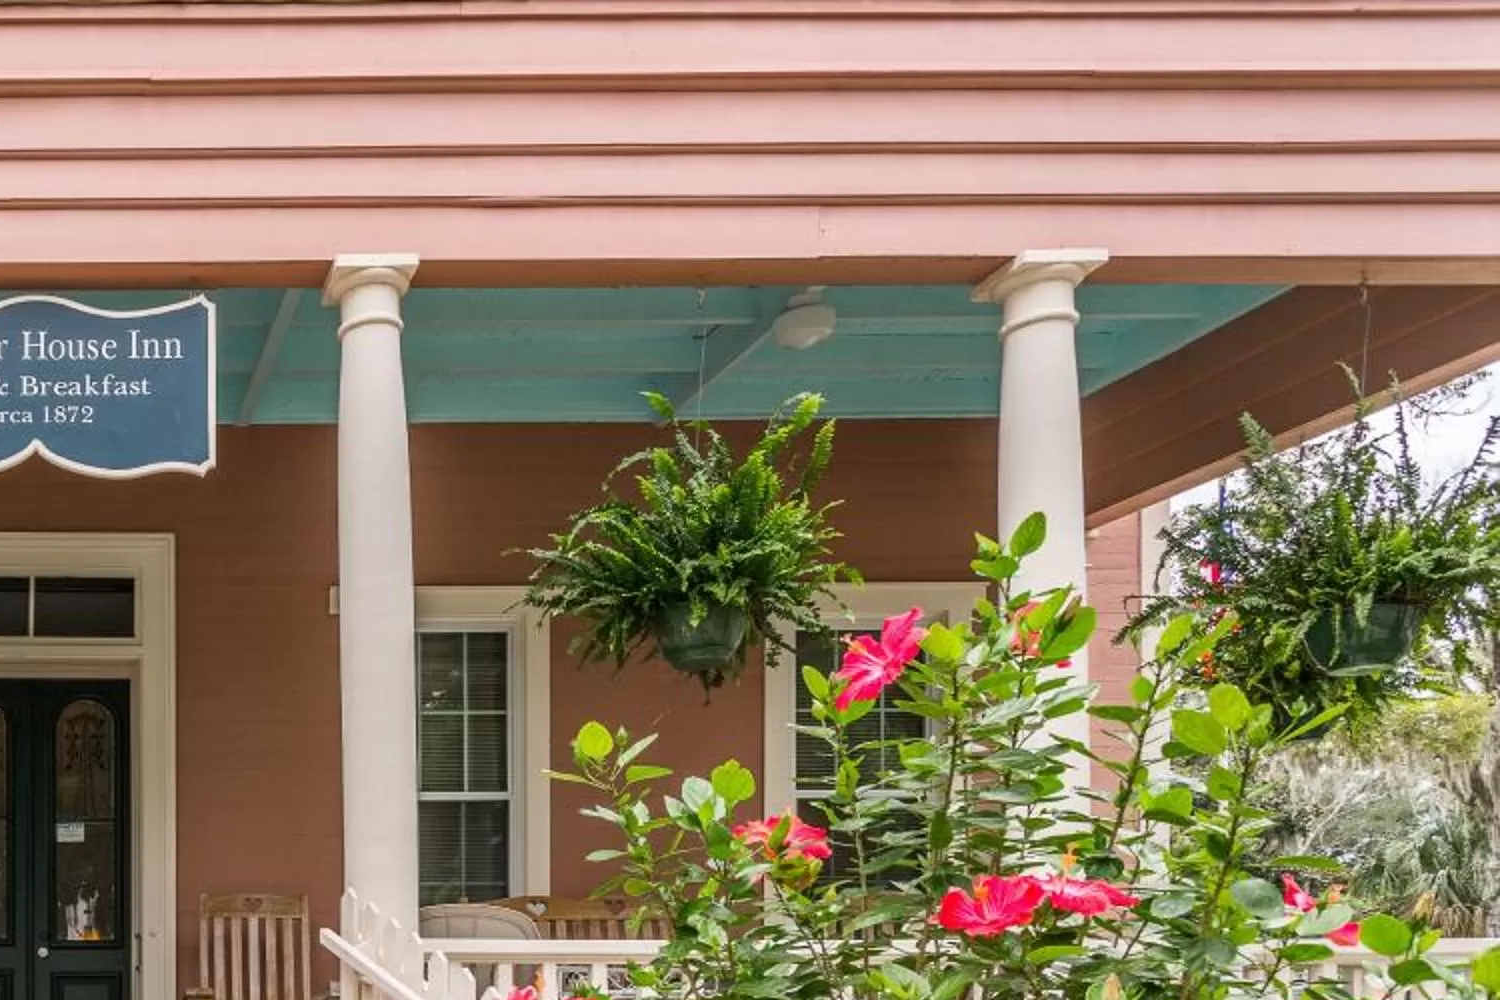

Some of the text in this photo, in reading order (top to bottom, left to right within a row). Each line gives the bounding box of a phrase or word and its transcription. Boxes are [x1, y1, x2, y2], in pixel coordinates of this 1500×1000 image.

[22, 331, 117, 361] House
[127, 329, 184, 359] Inn
[20, 375, 152, 397] Breakfast
[43, 406, 93, 424] 1872
